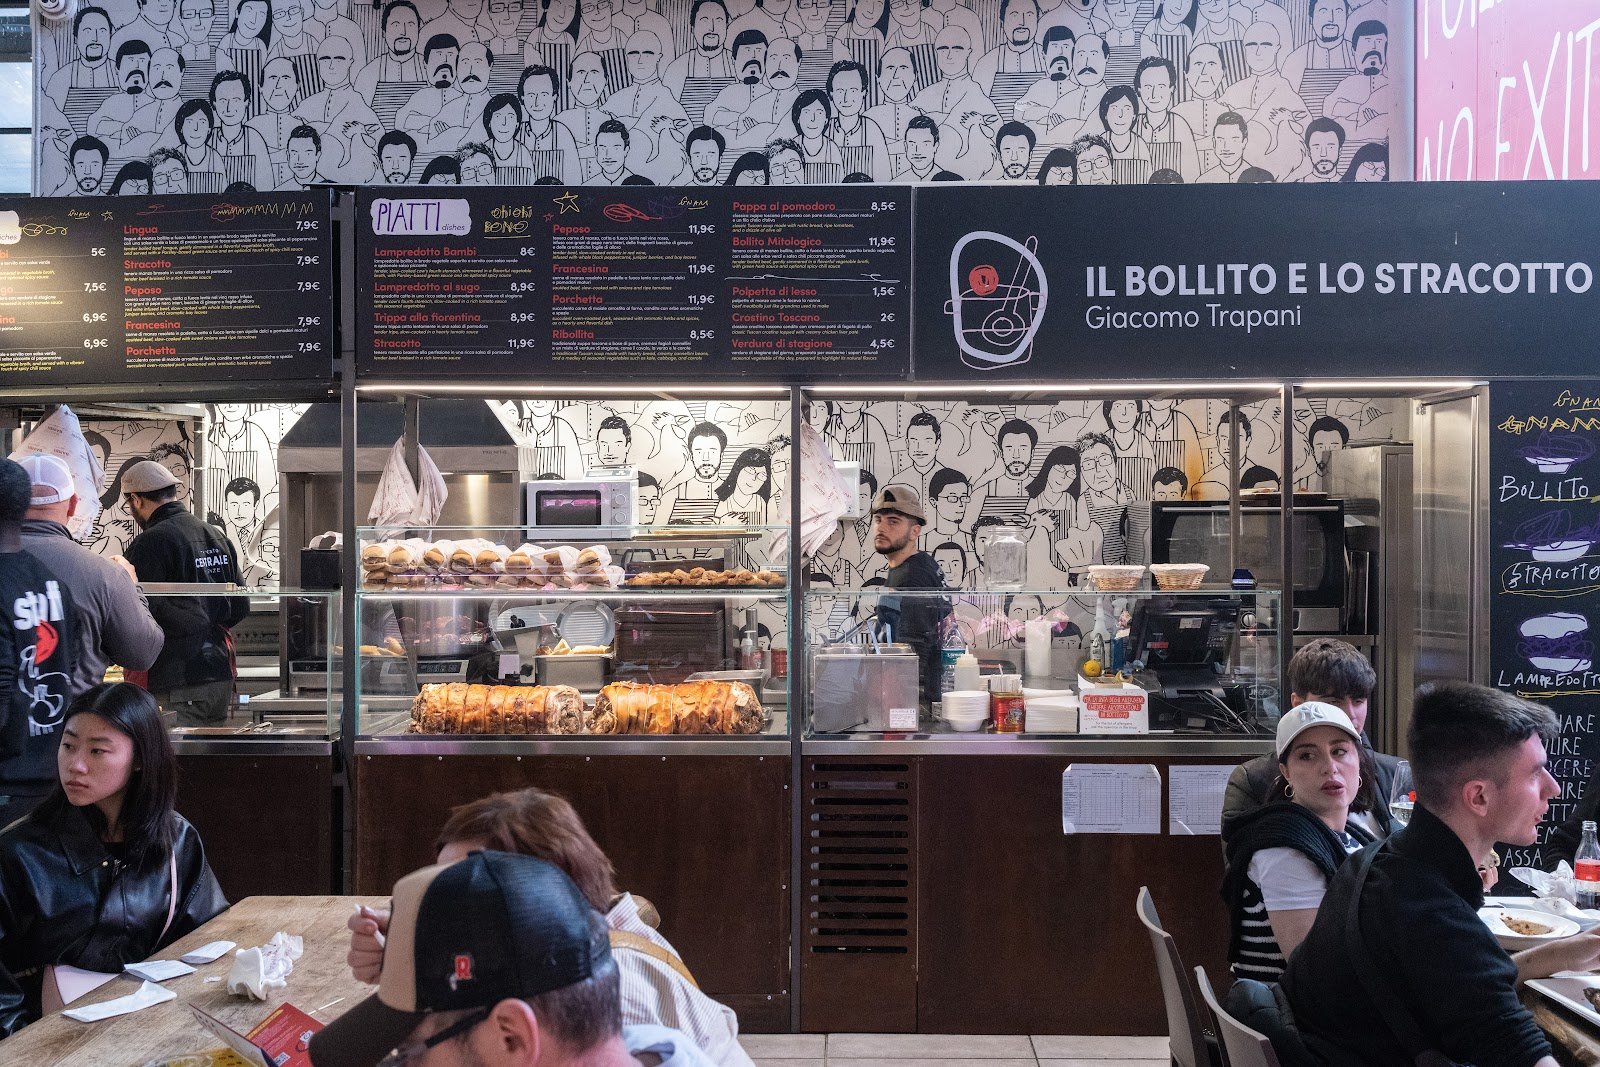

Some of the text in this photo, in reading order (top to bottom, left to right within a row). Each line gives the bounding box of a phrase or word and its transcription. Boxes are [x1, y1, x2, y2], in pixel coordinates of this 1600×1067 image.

[1494, 17, 1600, 181] EXIT
[733, 202, 895, 213] Pappa al pomodoro 8,5€
[377, 202, 440, 232] PIATTI
[124, 221, 318, 236] Lingua 7,9€
[554, 225, 715, 235] Peposo 11,9€
[733, 237, 895, 248] Bollito Mitologico 11,9€
[92, 248, 106, 256] 5€
[375, 247, 535, 258] Lampredotto Bambi 8€
[123, 256, 319, 269] Stracotto 7,9€
[553, 264, 715, 274] Francesina 11,9€
[1087, 262, 1593, 296] IL BOLLITO E LO STRACOTTO
[84, 283, 106, 293] 7,5€
[125, 282, 320, 297] Peposo 7,9€
[375, 282, 535, 293] Lampredotto al sugo 8,9€
[733, 287, 895, 298] Polpetta di lesso 1,5€
[553, 294, 714, 305] Porchetta 11,9€
[83, 313, 107, 323] 6,9€
[375, 312, 535, 324] Trippa alla fiorentina 8,9€
[732, 313, 895, 321] Crostino Toscano 2€
[1086, 304, 1300, 333] Giacomo Trapani
[126, 317, 320, 329] Francesina 7,9€
[553, 330, 714, 340] Ribollita 8,5€
[84, 339, 108, 349] 6,9€
[127, 343, 320, 355] Porchetta 7,9€
[374, 339, 534, 349] Stracotto 11,9€
[732, 339, 894, 350] Verdura di stagione 4,5€
[1498, 475, 1589, 502] BOLLITO
[1508, 563, 1600, 588] STRACOTTO
[1498, 670, 1600, 688] LAMPREDOTT
